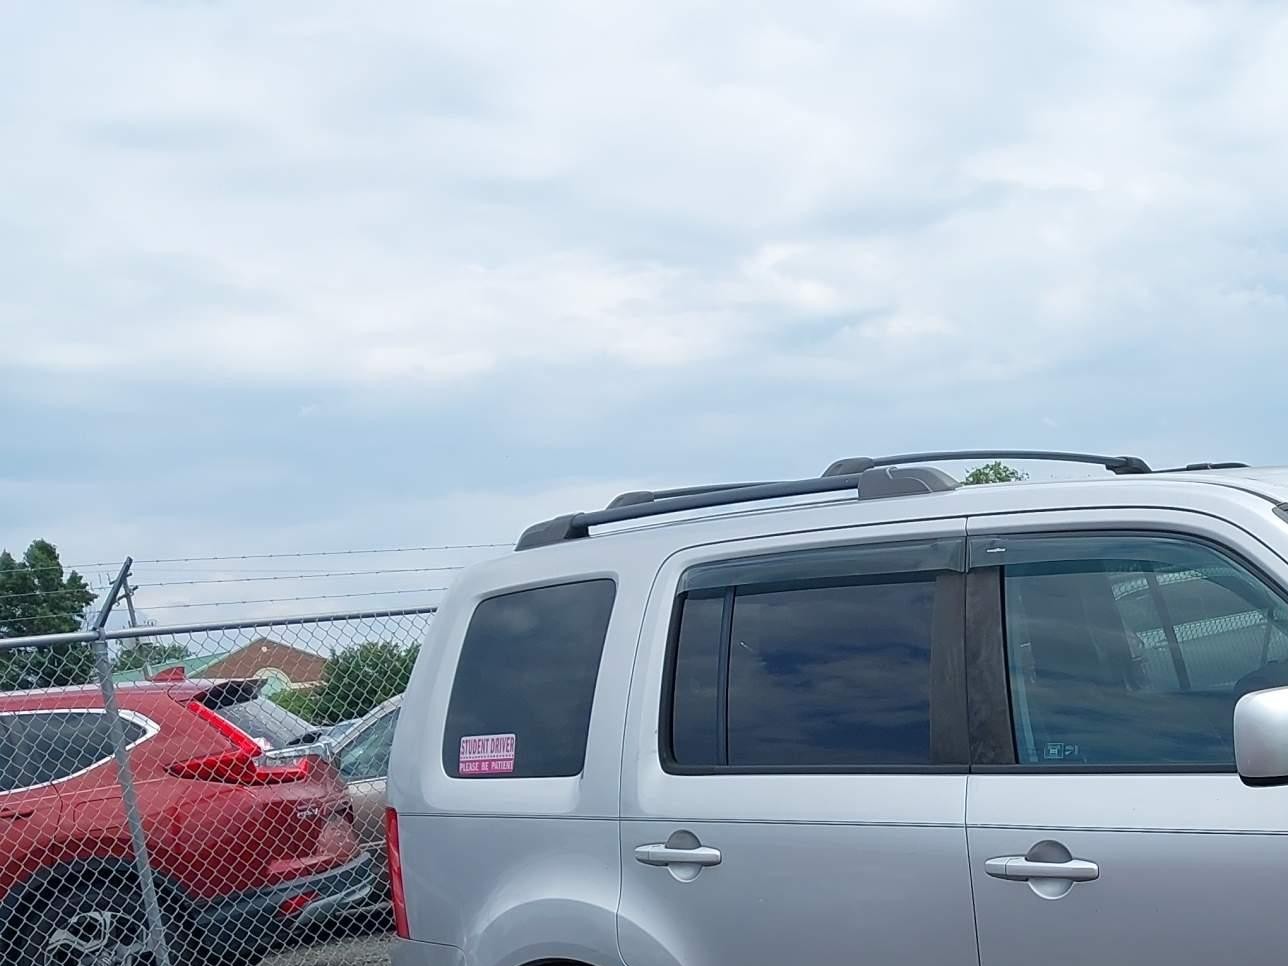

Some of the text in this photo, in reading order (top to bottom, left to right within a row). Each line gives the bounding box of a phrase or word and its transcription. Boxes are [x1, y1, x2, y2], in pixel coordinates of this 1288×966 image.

[462, 737, 514, 754] STUDENT DRIVER
[460, 760, 513, 772] PLEASE BE PATIENT
